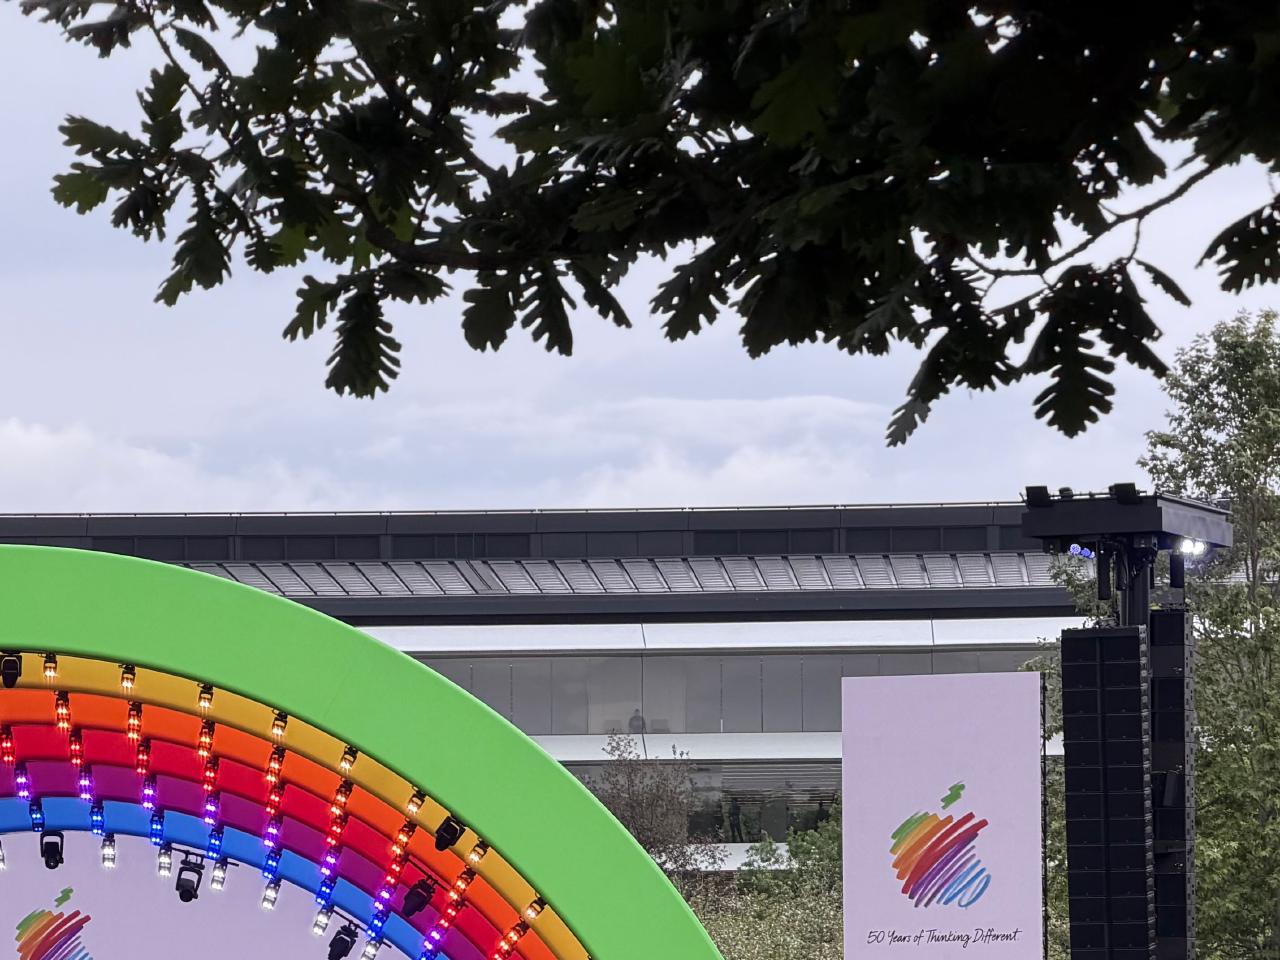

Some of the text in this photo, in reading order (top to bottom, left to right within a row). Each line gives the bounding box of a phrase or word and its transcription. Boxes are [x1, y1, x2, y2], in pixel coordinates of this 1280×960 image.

[867, 930, 886, 944] 50
[888, 930, 911, 945] Years
[914, 929, 925, 945] of
[926, 929, 972, 948] Thinking
